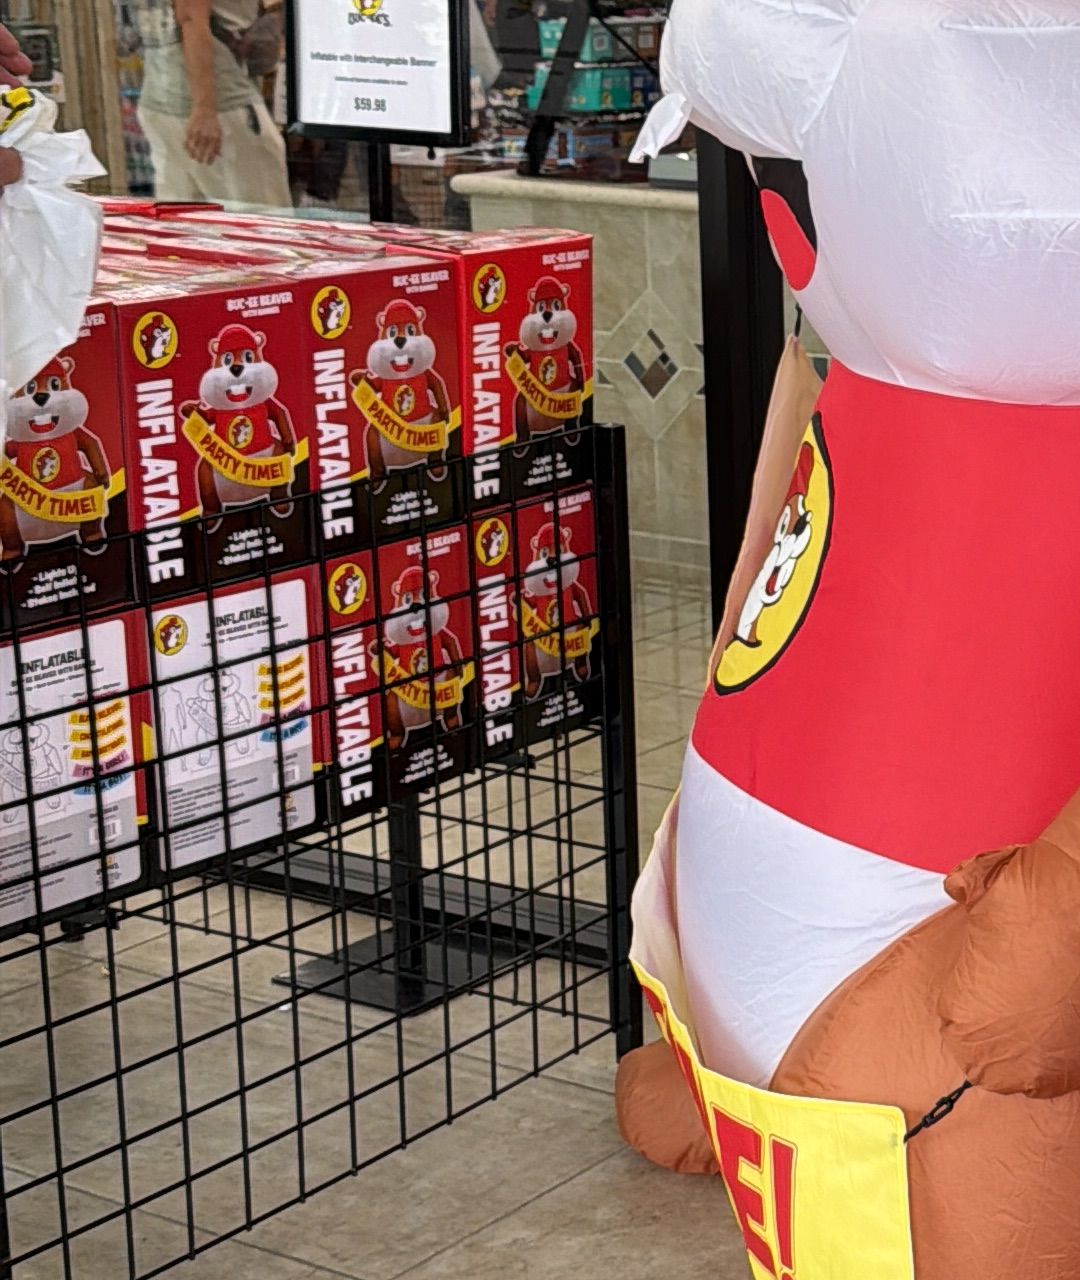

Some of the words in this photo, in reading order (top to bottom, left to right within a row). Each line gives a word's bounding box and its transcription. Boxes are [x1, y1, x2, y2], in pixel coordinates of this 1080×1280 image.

[200, 433, 241, 475] PARTY
[243, 462, 284, 481] TIME!
[313, 348, 354, 540] INFLATABLE
[367, 401, 405, 440] PARTY
[406, 429, 440, 447] TIME!
[472, 321, 501, 500] INFLATABLE
[0, 468, 46, 510] PARTY
[47, 494, 96, 517] TIME!
[136, 378, 185, 584] INFLATABLE
